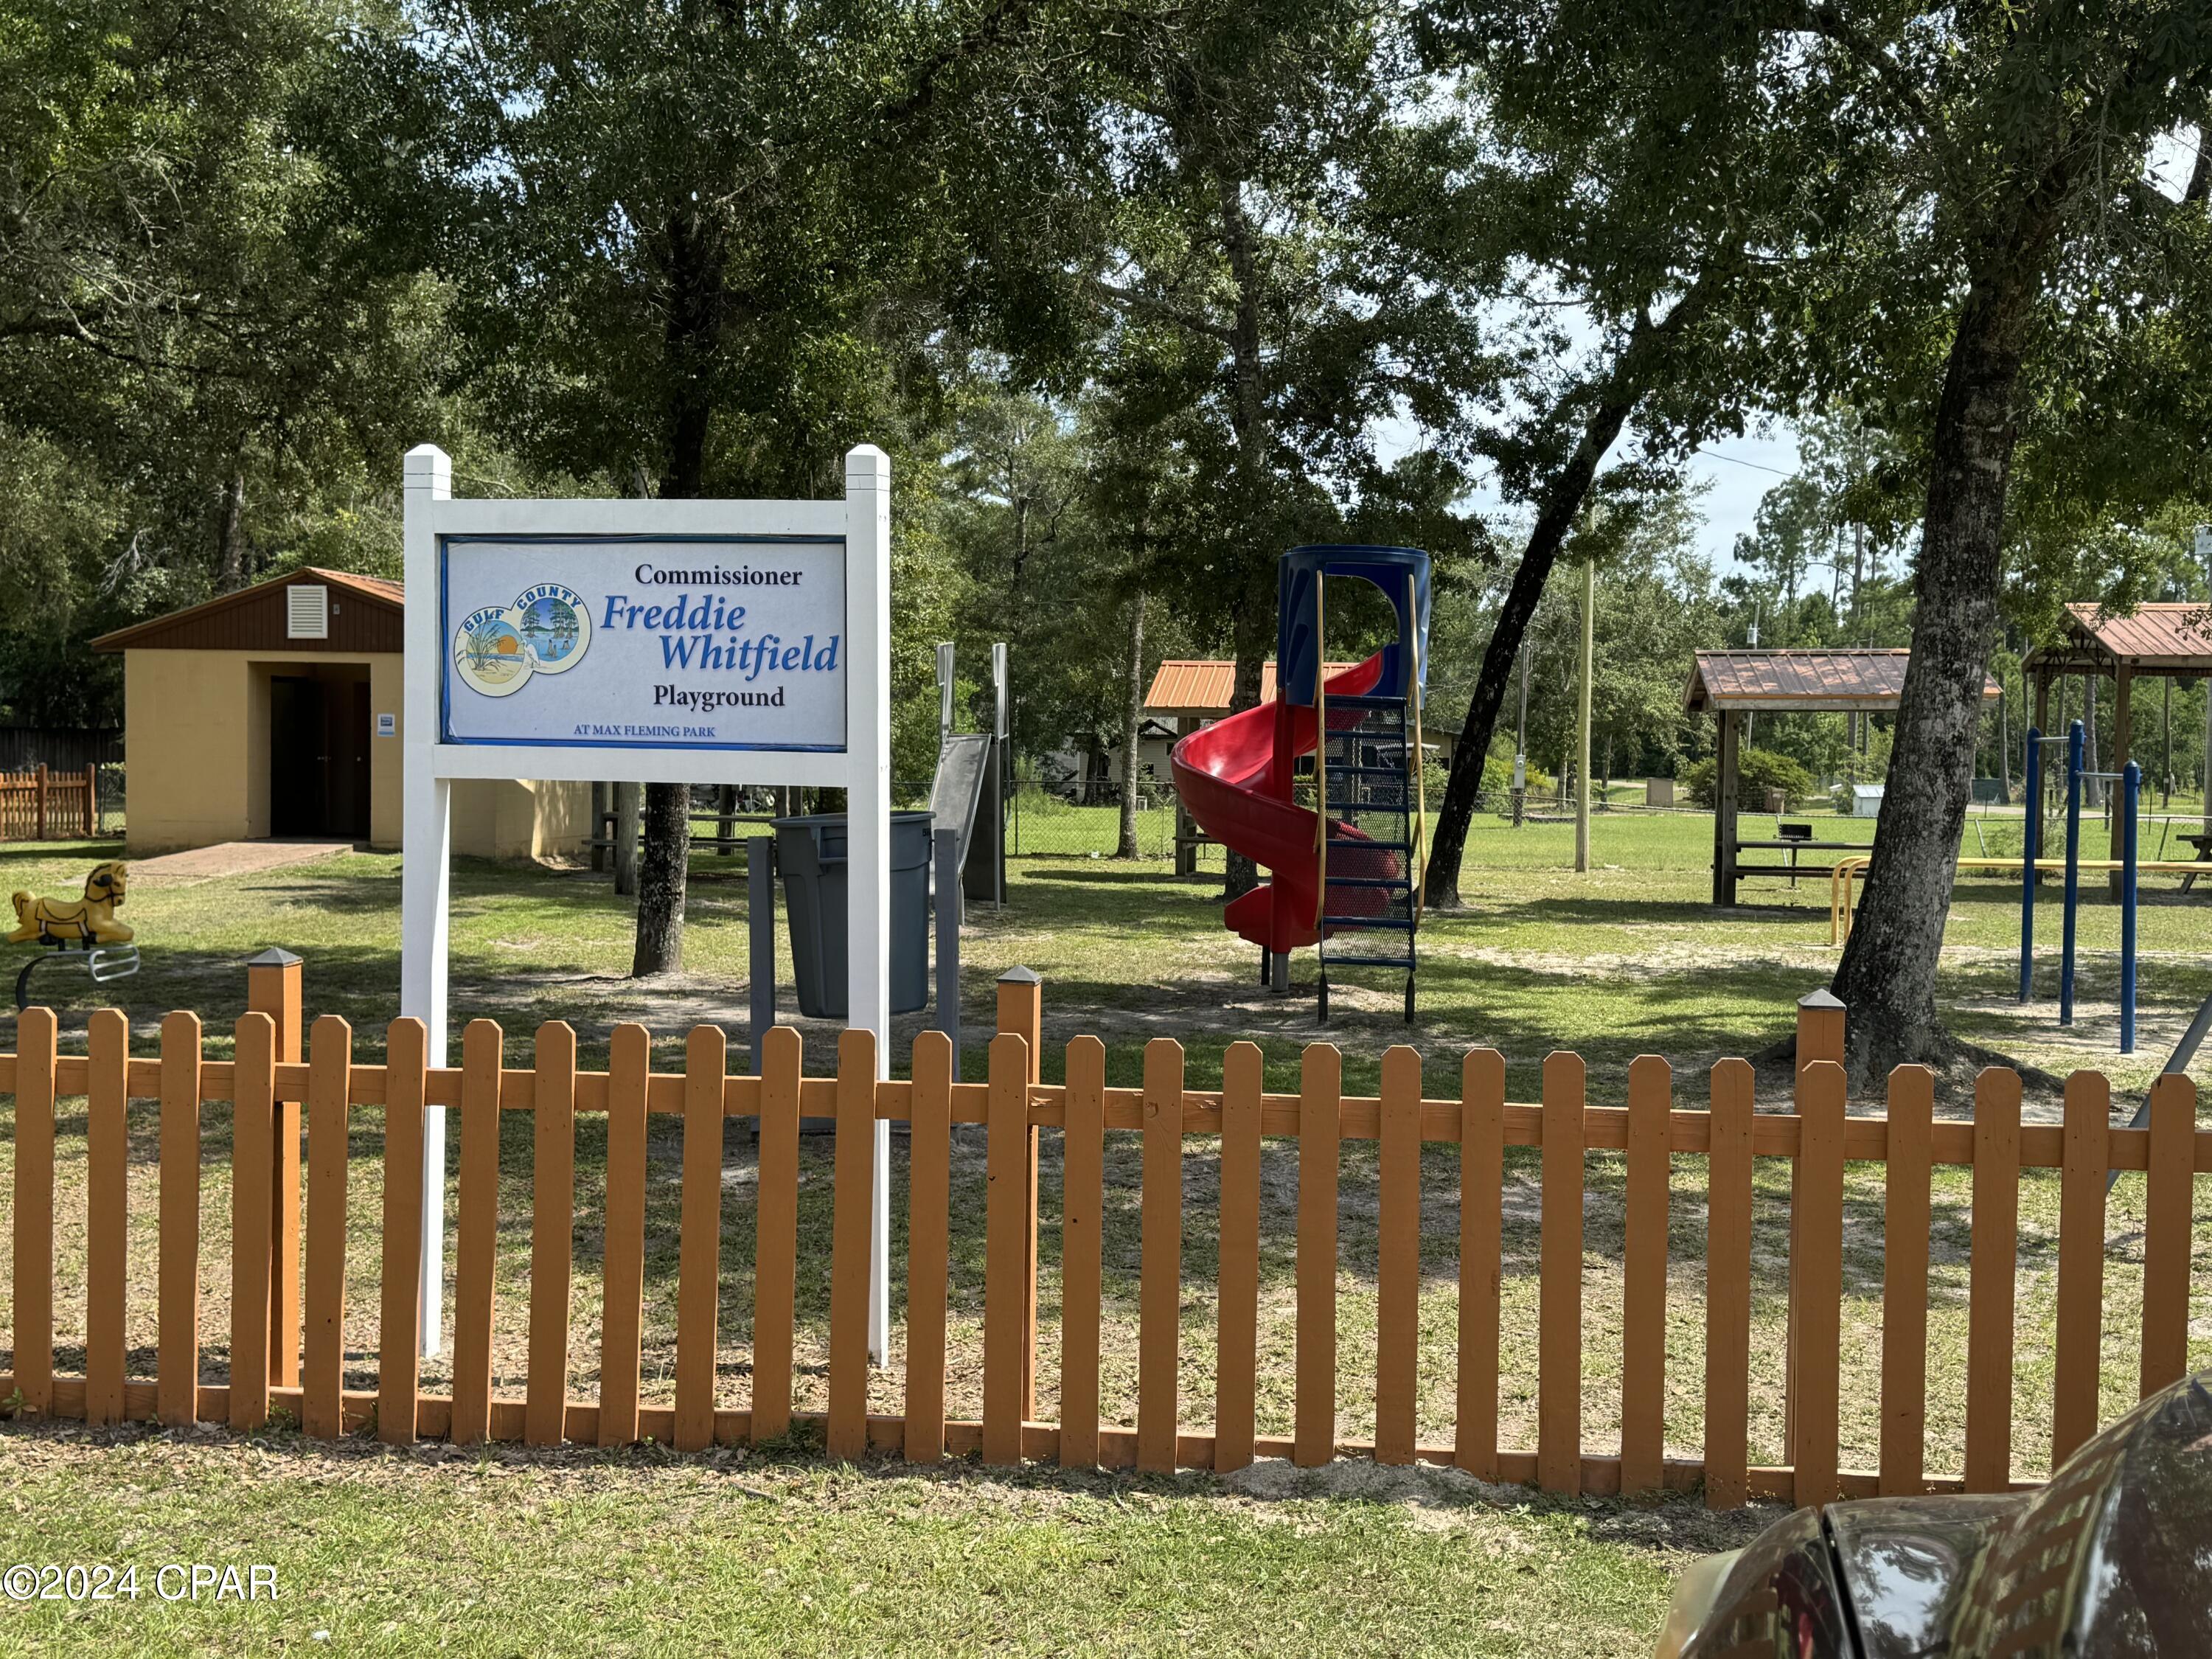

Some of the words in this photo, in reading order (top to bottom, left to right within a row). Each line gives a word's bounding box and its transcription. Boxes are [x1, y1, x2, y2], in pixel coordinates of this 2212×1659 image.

[635, 563, 803, 586] Commissioner
[463, 608, 504, 633] GULF
[516, 585, 581, 611] COUNTY
[600, 594, 746, 630] Freddie
[658, 633, 841, 681] Whitfield
[653, 684, 785, 712] Playground
[574, 724, 590, 734] AT
[592, 725, 621, 736] MAX
[625, 725, 680, 737] FLEMING
[683, 726, 716, 737] PARK
